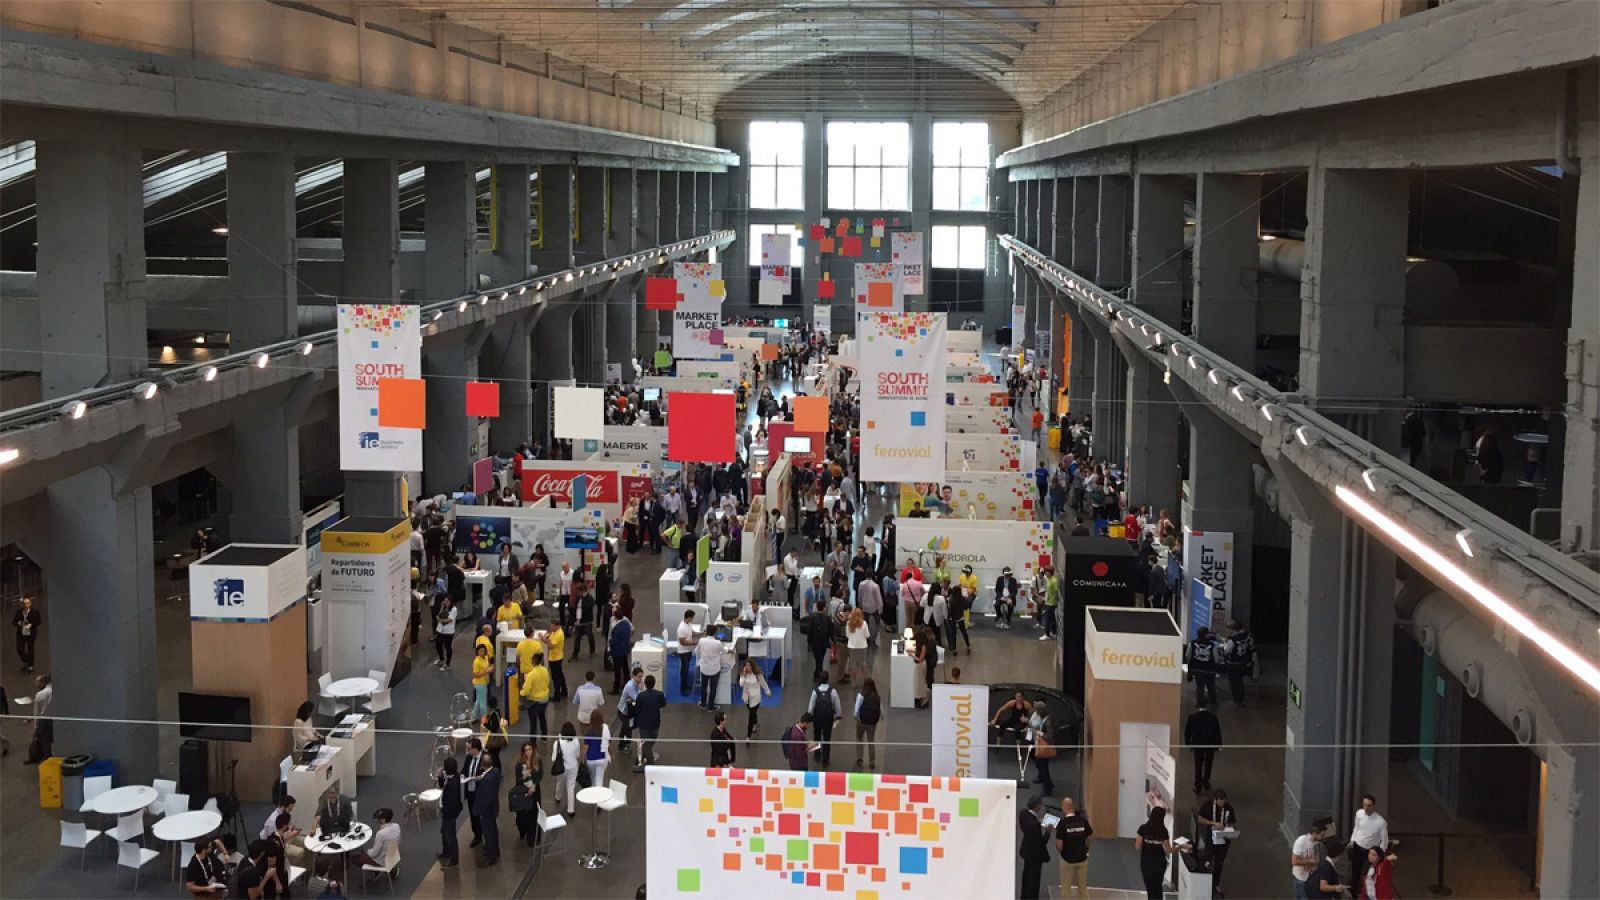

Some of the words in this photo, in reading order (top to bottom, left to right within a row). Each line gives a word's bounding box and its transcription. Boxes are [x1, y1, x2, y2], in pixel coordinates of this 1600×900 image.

[676, 312, 719, 320] MARKET
[685, 321, 718, 329] PLACE
[355, 363, 404, 375] SOUTH
[878, 372, 928, 384] SOUTH
[878, 385, 928, 395] SUMMIT
[603, 441, 648, 449] MAERSK
[874, 444, 931, 458] ferrovial
[331, 559, 376, 567] Repartidores
[1201, 545, 1213, 587] RKET
[341, 568, 375, 576] FUTURO
[1213, 561, 1227, 611] PLACE
[224, 585, 245, 606] ie
[1101, 648, 1176, 668] ferrovial
[949, 694, 971, 777] errovial
